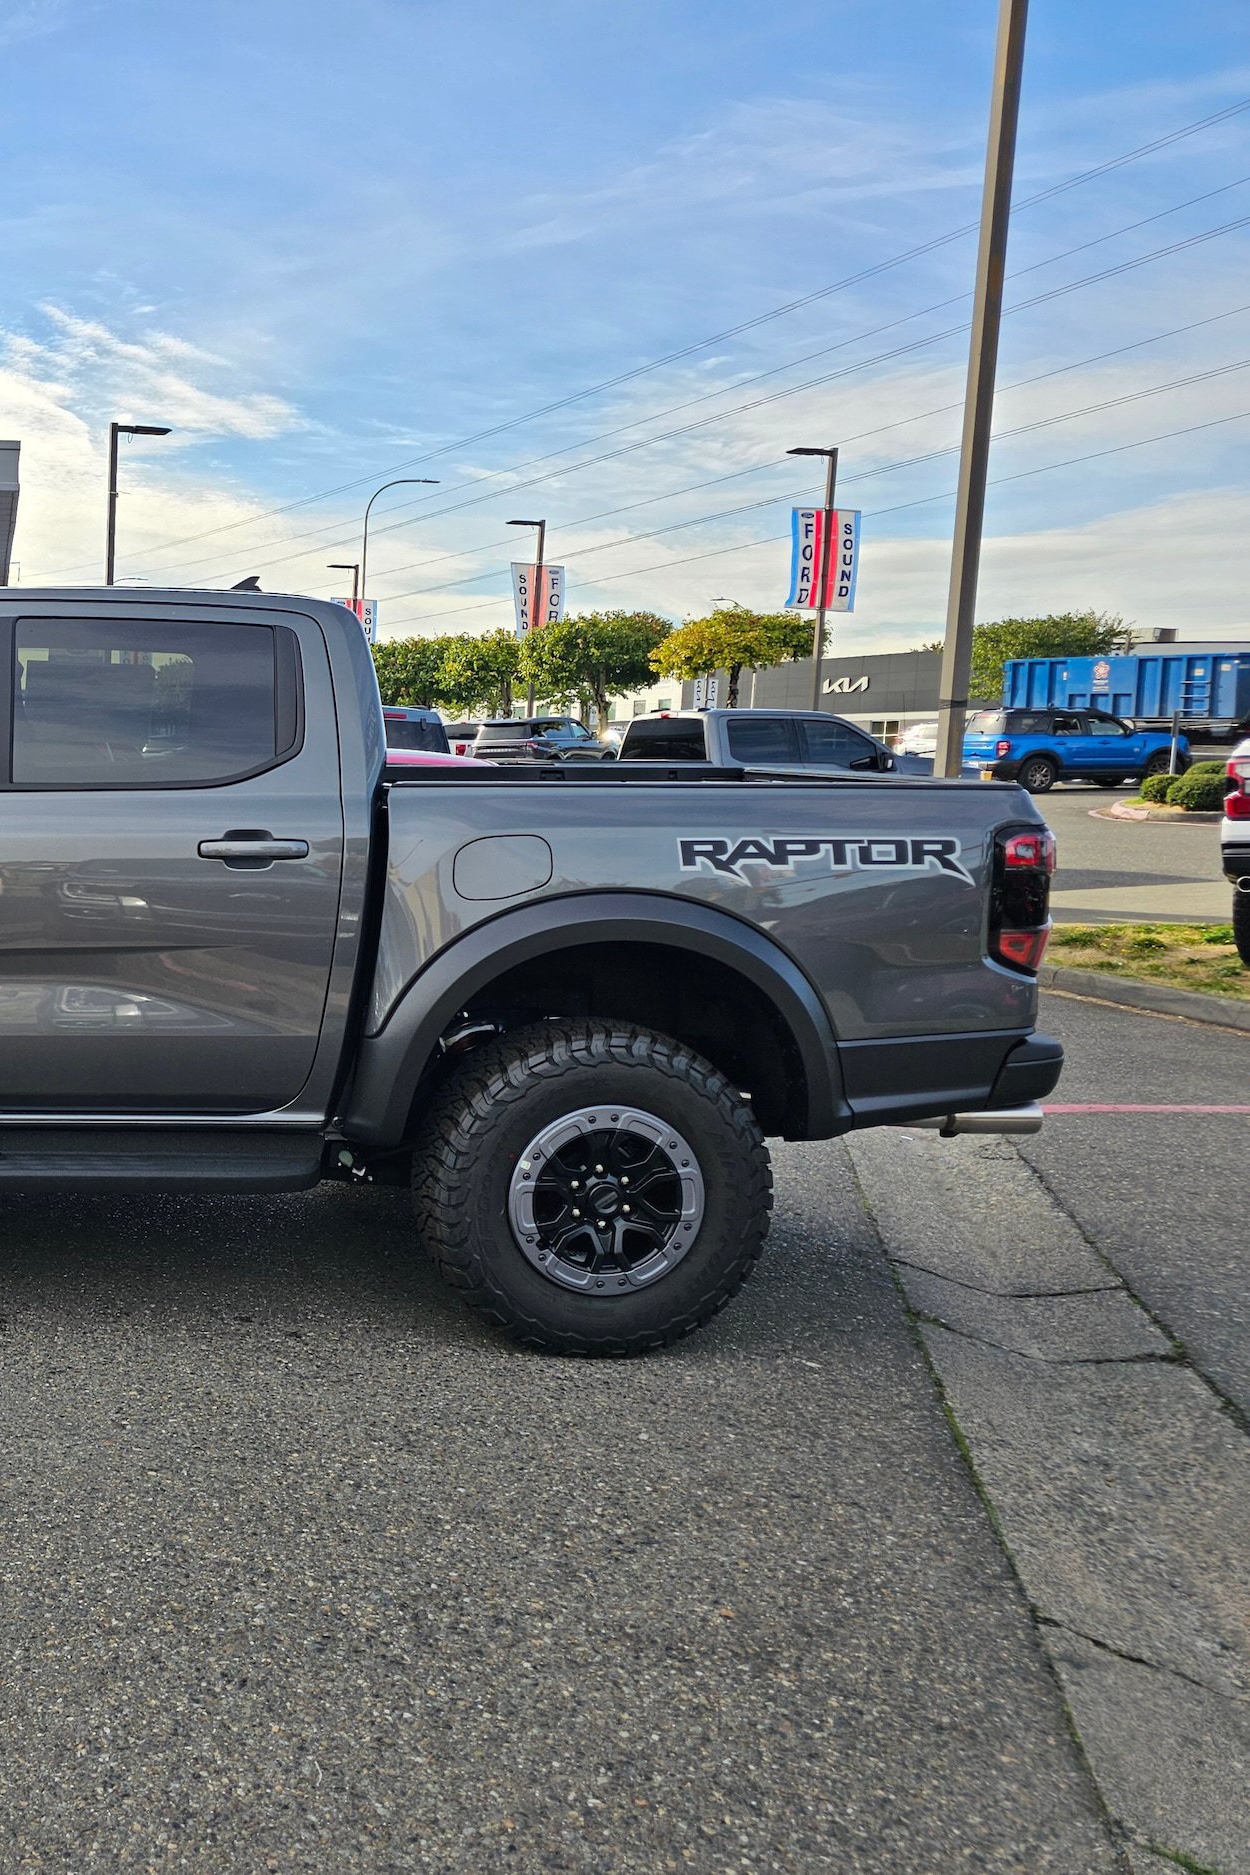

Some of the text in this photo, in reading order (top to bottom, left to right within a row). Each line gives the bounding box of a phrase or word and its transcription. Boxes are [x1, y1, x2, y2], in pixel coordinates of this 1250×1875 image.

[797, 523, 814, 604] FORD
[838, 523, 854, 598] SOUND
[518, 574, 529, 630] SOUND
[822, 676, 869, 694] KIA
[676, 837, 977, 888] RAPTOR
